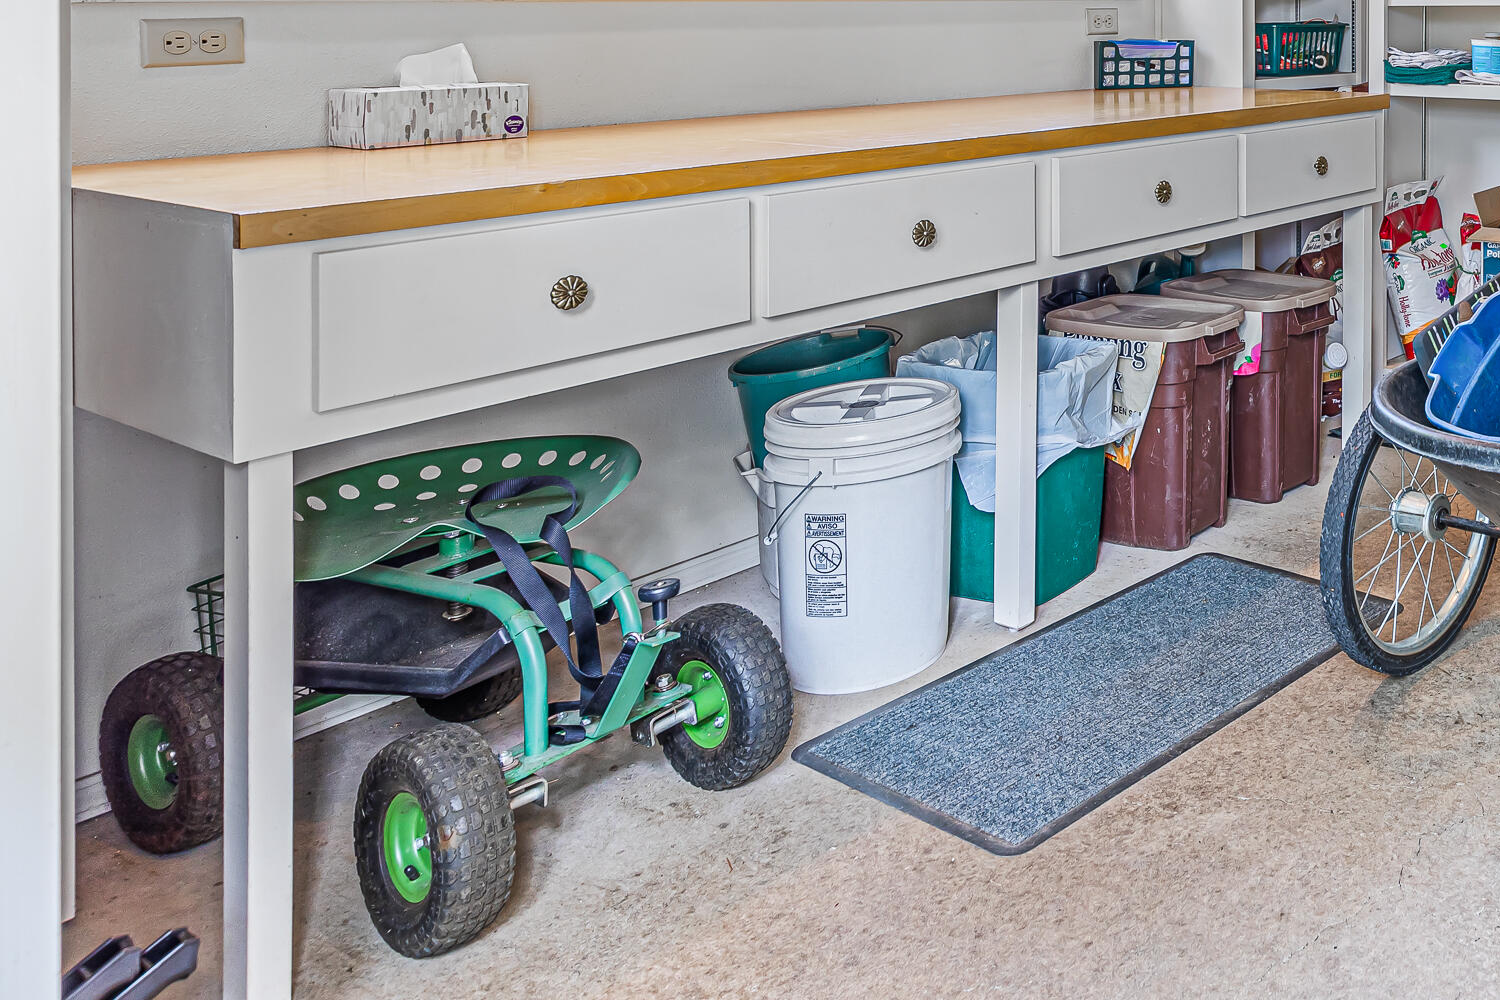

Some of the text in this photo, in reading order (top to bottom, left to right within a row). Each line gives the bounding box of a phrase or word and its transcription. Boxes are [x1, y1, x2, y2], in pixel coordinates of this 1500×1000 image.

[1409, 237, 1436, 254] ORGANIC
[1399, 295, 1411, 328] Holly-tone
[1113, 405, 1127, 415] DEN
